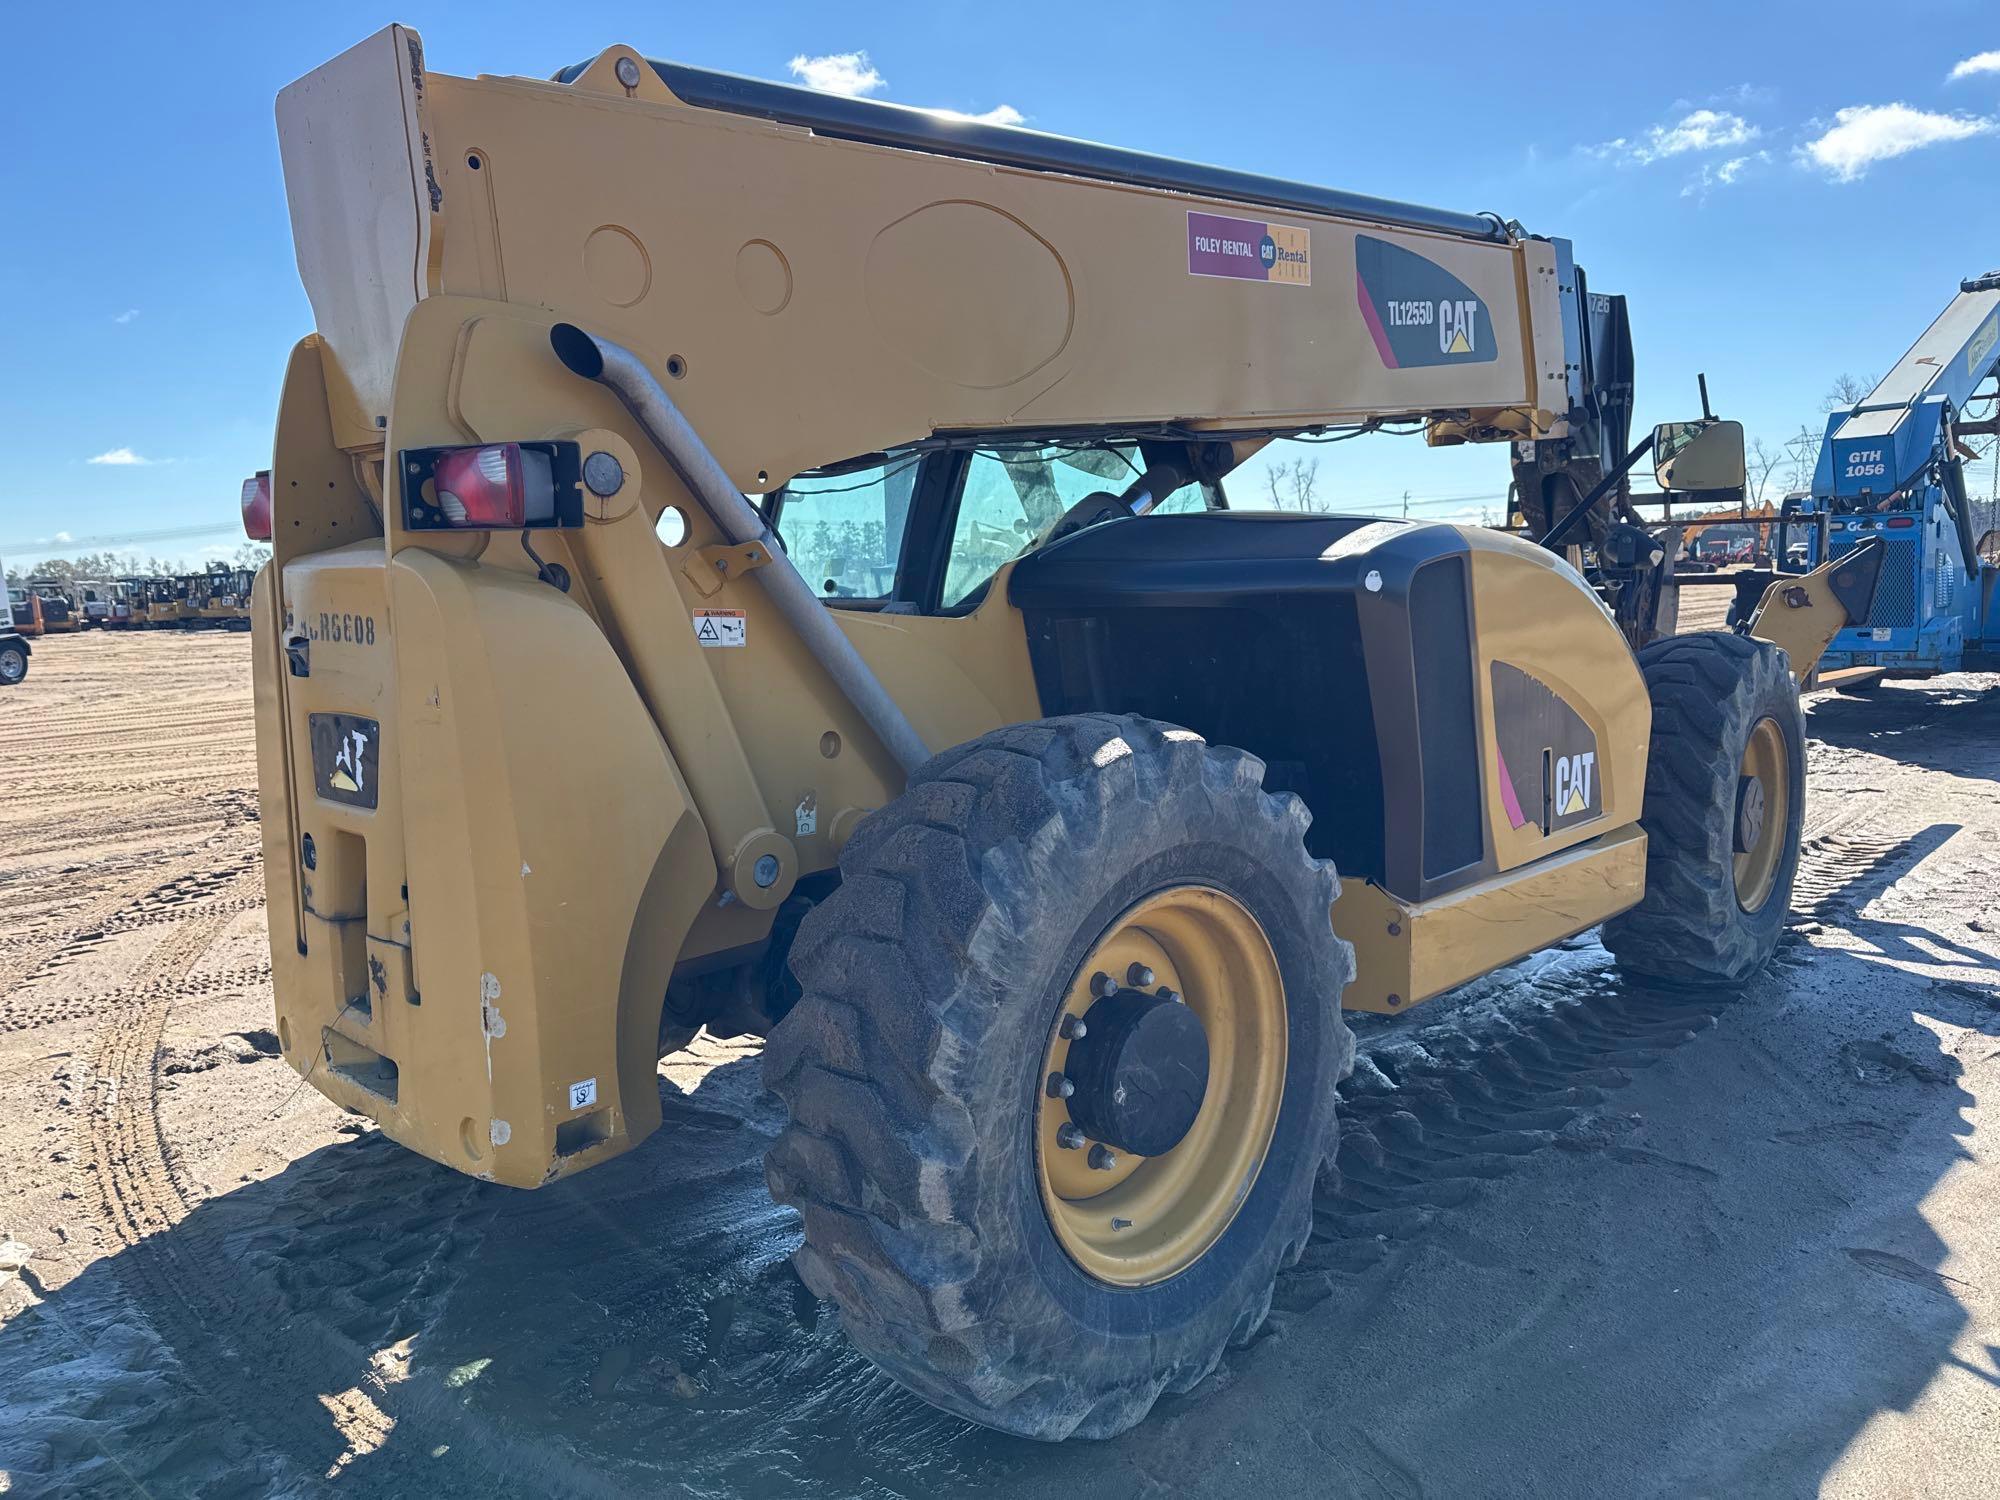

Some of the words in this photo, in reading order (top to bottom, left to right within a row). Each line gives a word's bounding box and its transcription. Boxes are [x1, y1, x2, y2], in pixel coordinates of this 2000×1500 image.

[1195, 236, 1221, 253] FOLEY
[1222, 239, 1253, 257] RENTAL
[1261, 244, 1274, 259] CAT
[1277, 247, 1307, 263] Rental
[1387, 300, 1434, 326] TL1255D
[1439, 299, 1477, 354] CAT
[1848, 450, 1882, 464] GTH
[1845, 463, 1885, 478] 1056
[1555, 751, 1595, 818] CAT
